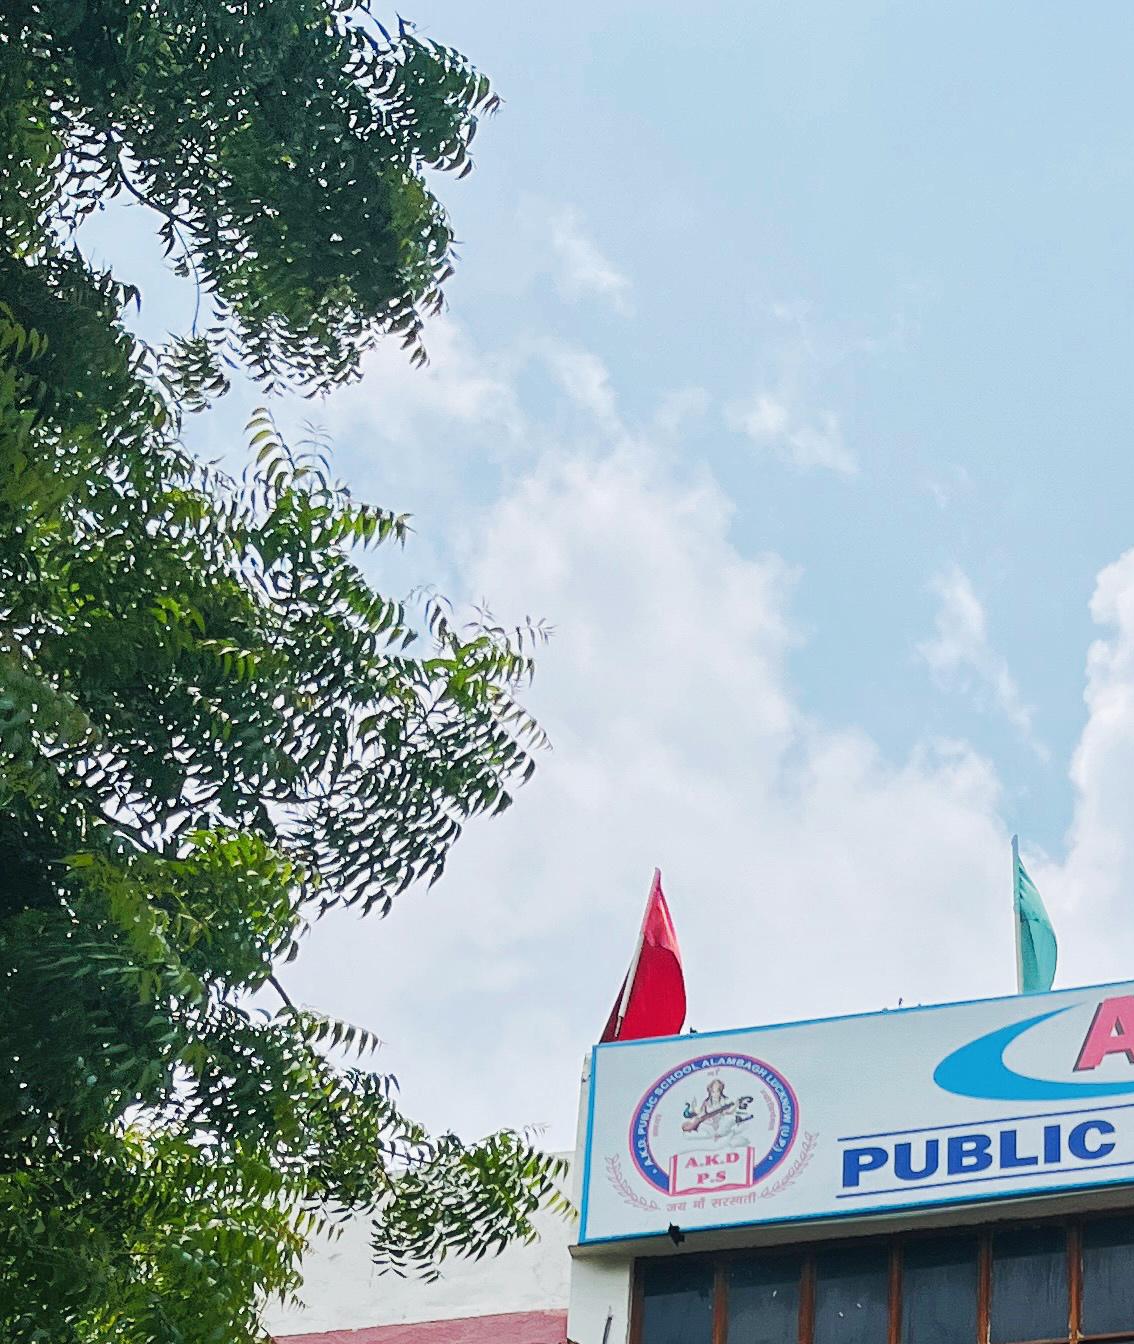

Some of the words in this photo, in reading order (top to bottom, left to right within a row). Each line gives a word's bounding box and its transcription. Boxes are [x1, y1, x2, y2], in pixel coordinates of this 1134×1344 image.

[638, 1095, 658, 1136] PUBLIC
[655, 1062, 700, 1098] SCHOOL
[701, 1056, 767, 1078] ALAMBAGH
[764, 1073, 793, 1124] LUCKNOW
[842, 1122, 1115, 1189] PUBLIC
